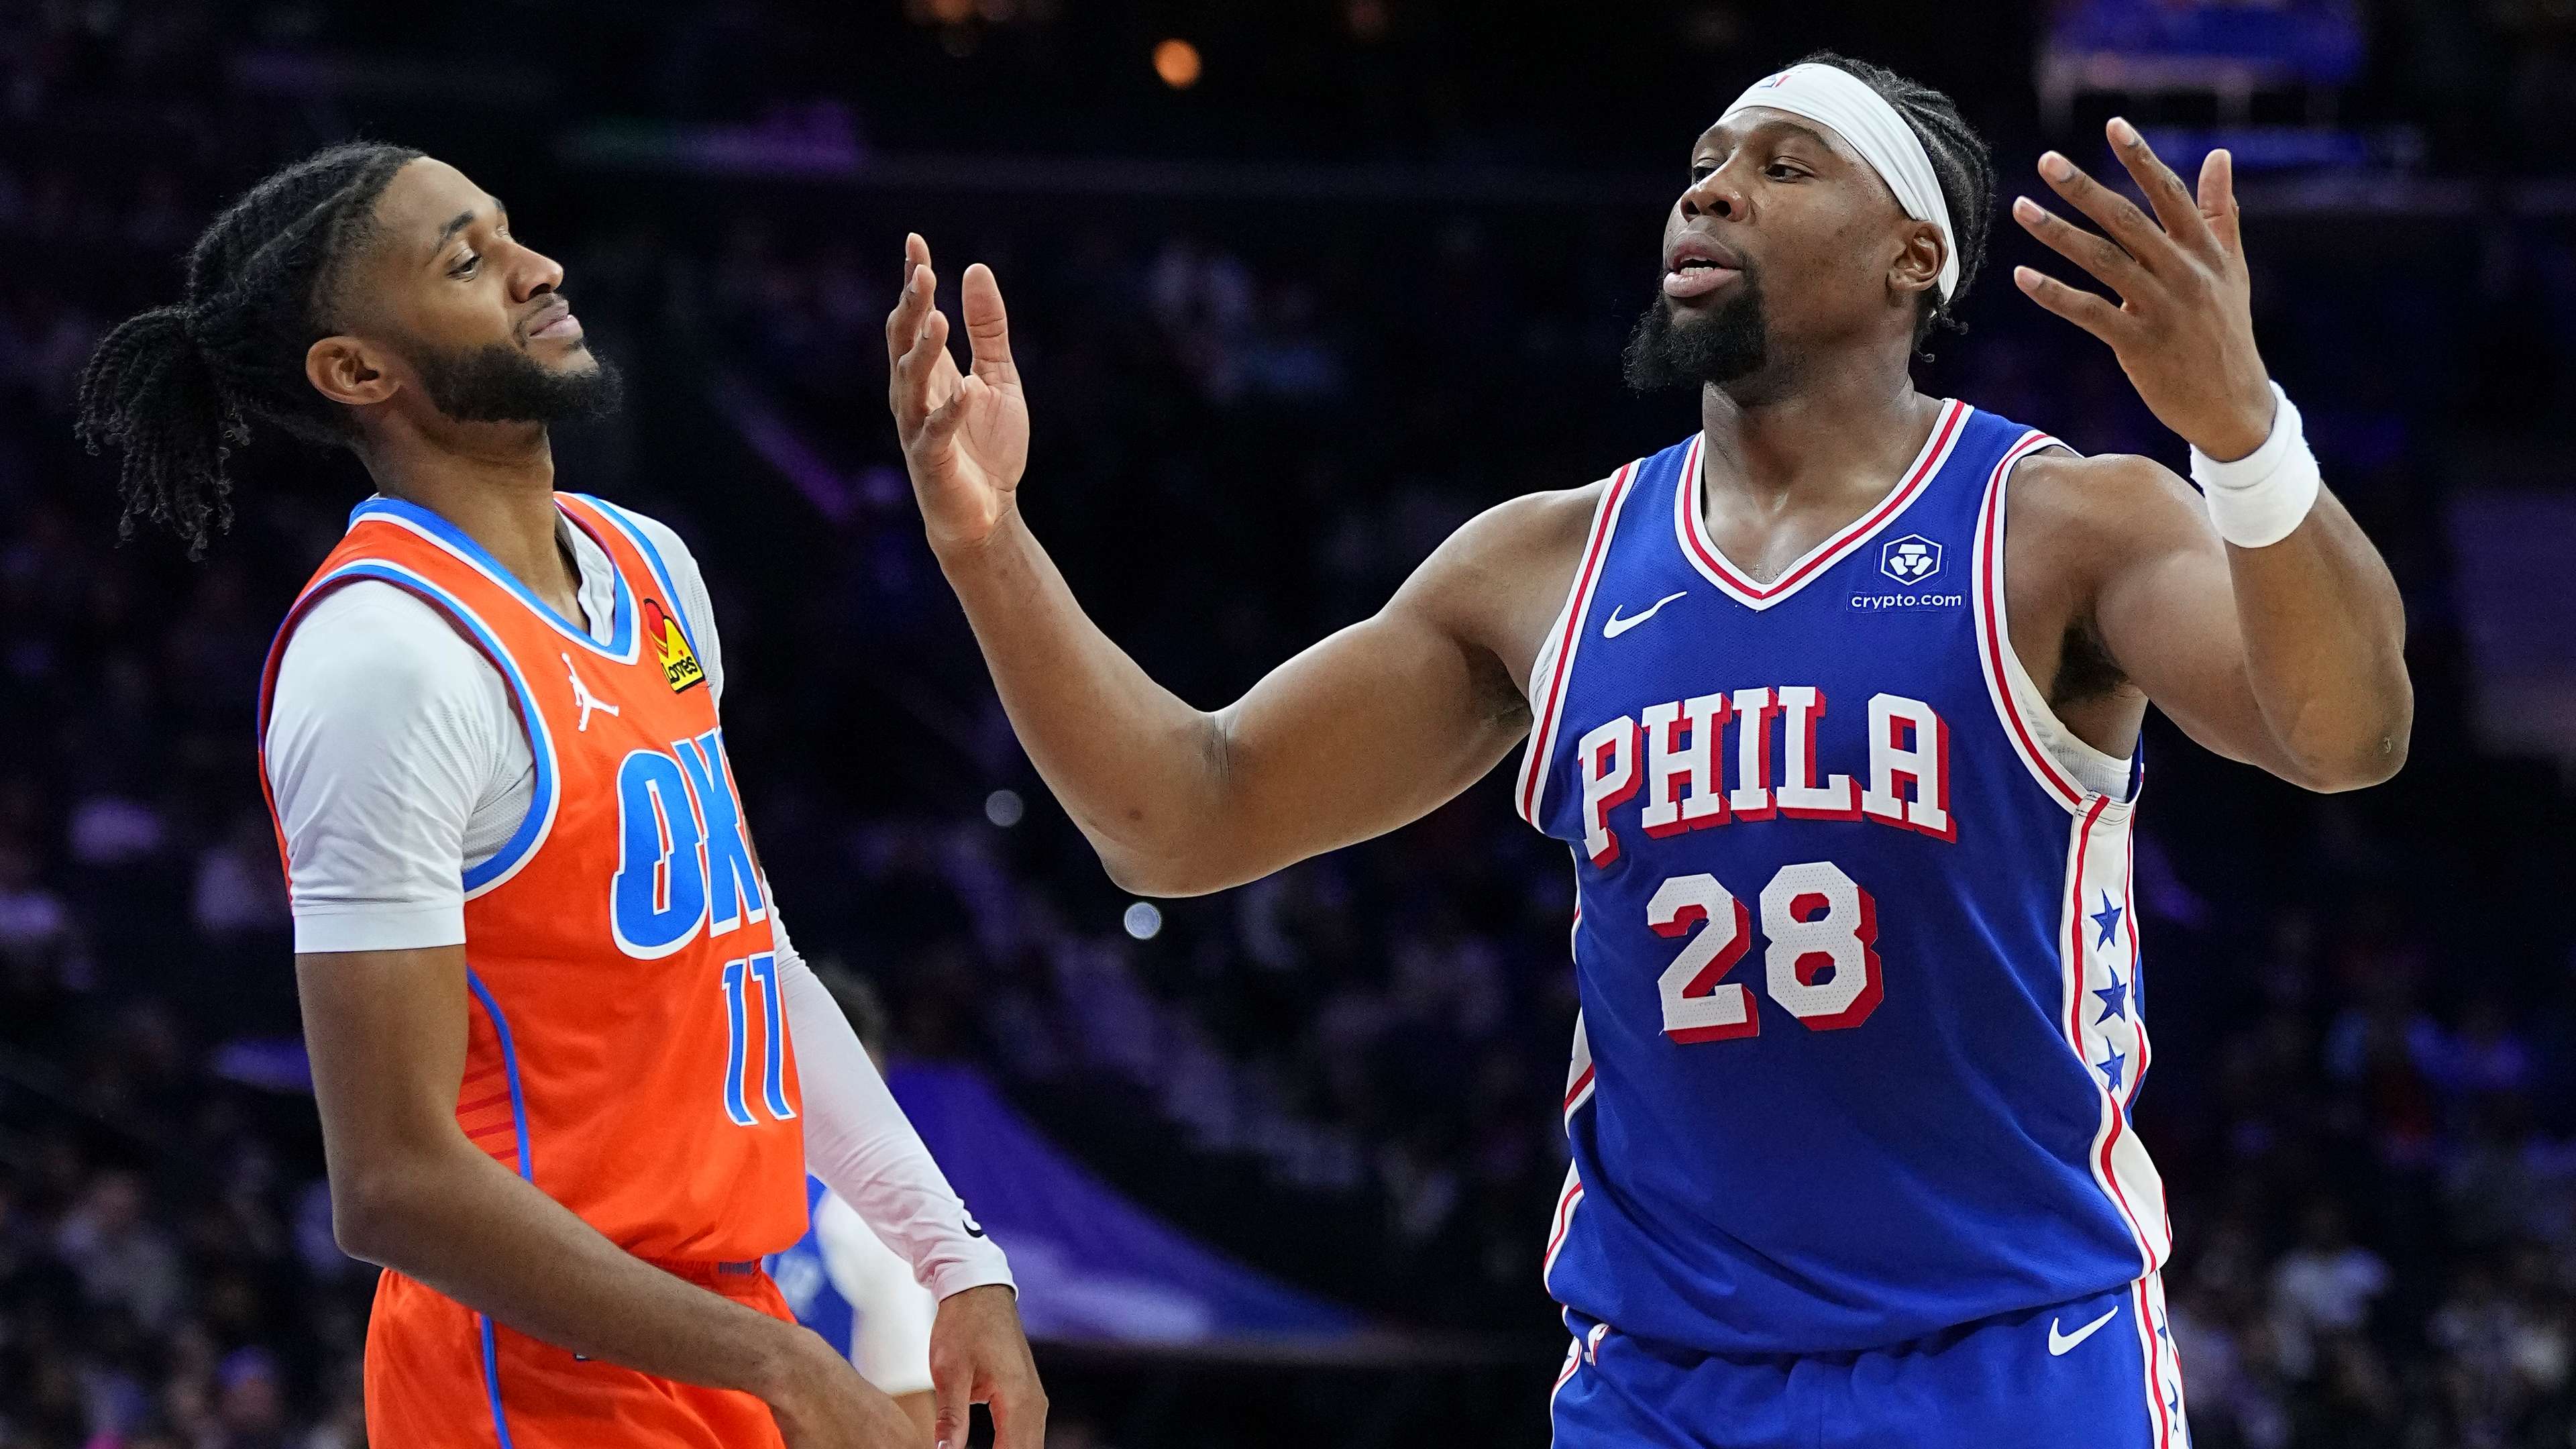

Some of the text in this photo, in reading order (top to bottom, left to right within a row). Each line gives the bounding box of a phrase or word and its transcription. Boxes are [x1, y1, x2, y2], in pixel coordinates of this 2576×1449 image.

[1851, 593, 1962, 609] crypto.com
[609, 725, 767, 960] OK
[1578, 686, 1957, 869] PHILA
[721, 951, 797, 1126] 11
[1646, 861, 1884, 1044] 28
